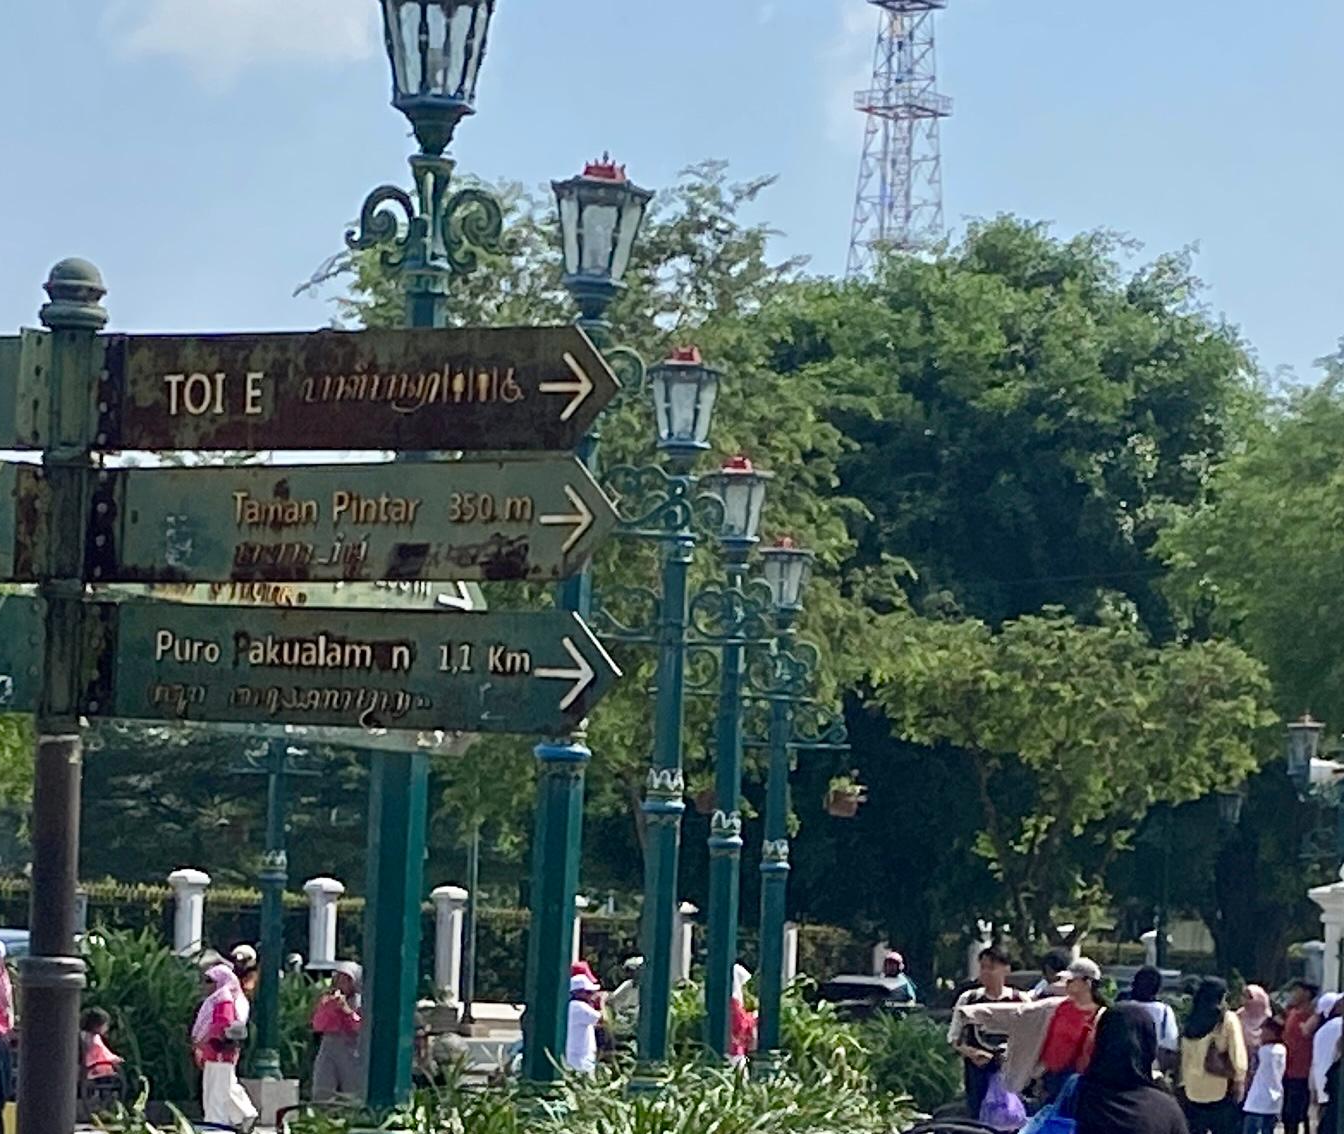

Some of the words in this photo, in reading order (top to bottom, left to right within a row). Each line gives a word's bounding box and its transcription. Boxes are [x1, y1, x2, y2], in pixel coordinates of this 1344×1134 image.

[232, 490, 318, 524] Taman
[331, 490, 423, 524] Pintar
[447, 492, 494, 523] 350
[504, 494, 534, 522] m
[156, 630, 221, 664] Puro
[487, 645, 531, 674] Km
